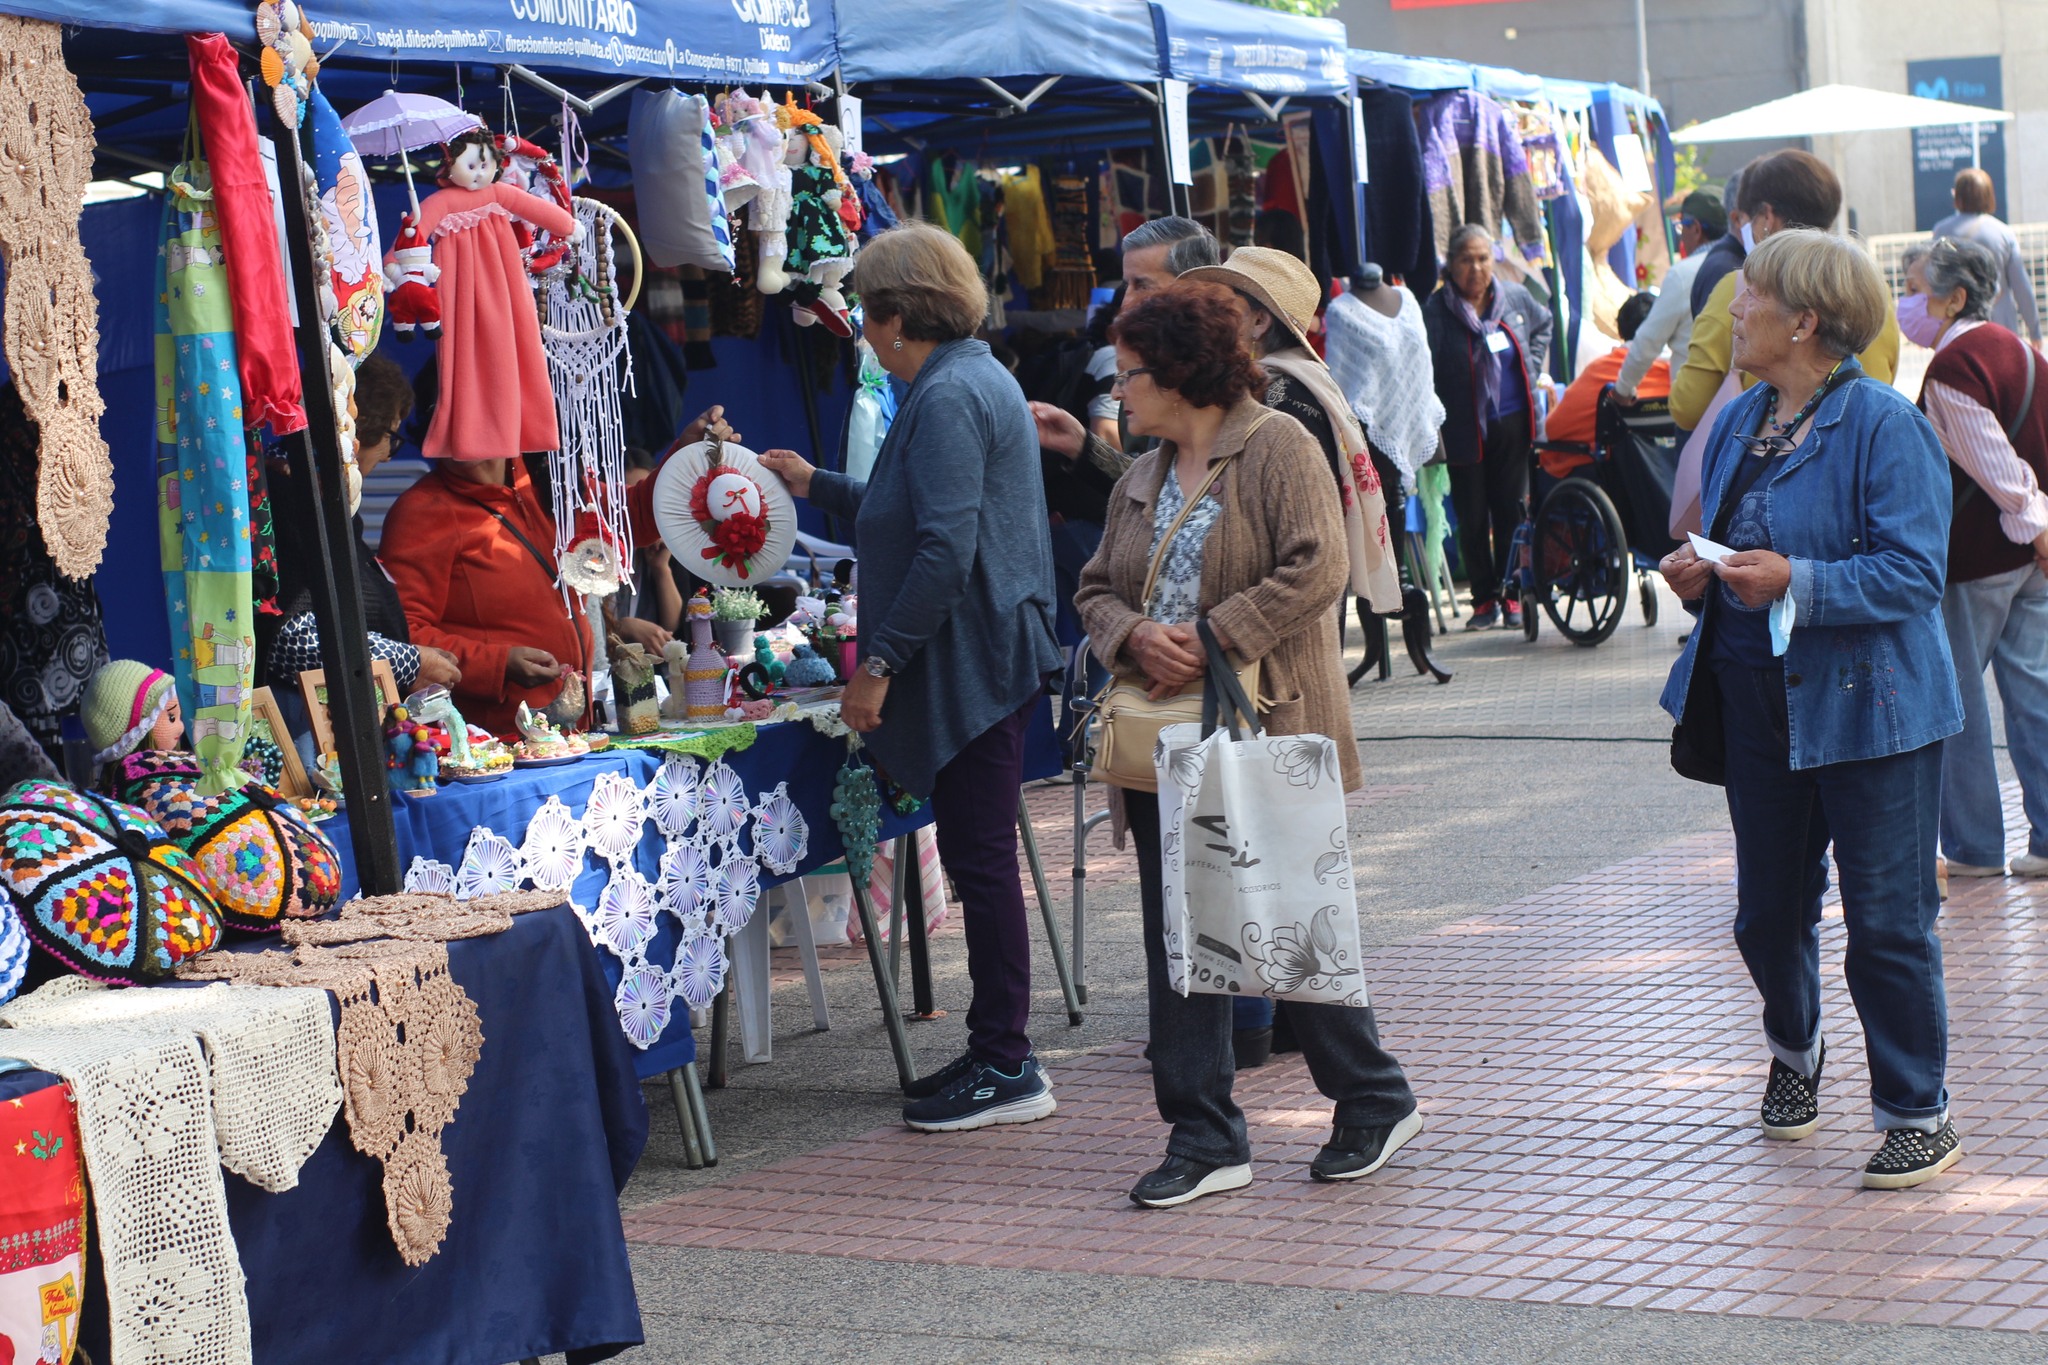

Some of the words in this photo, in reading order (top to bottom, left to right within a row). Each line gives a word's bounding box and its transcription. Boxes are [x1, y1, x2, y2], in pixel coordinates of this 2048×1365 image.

[510, 0, 638, 37] COMUNITARIO
[376, 29, 488, 52] social.dideco@quillota.cl
[674, 47, 684, 64] La
[685, 48, 725, 72] Concepción
[759, 27, 791, 52] Dideco
